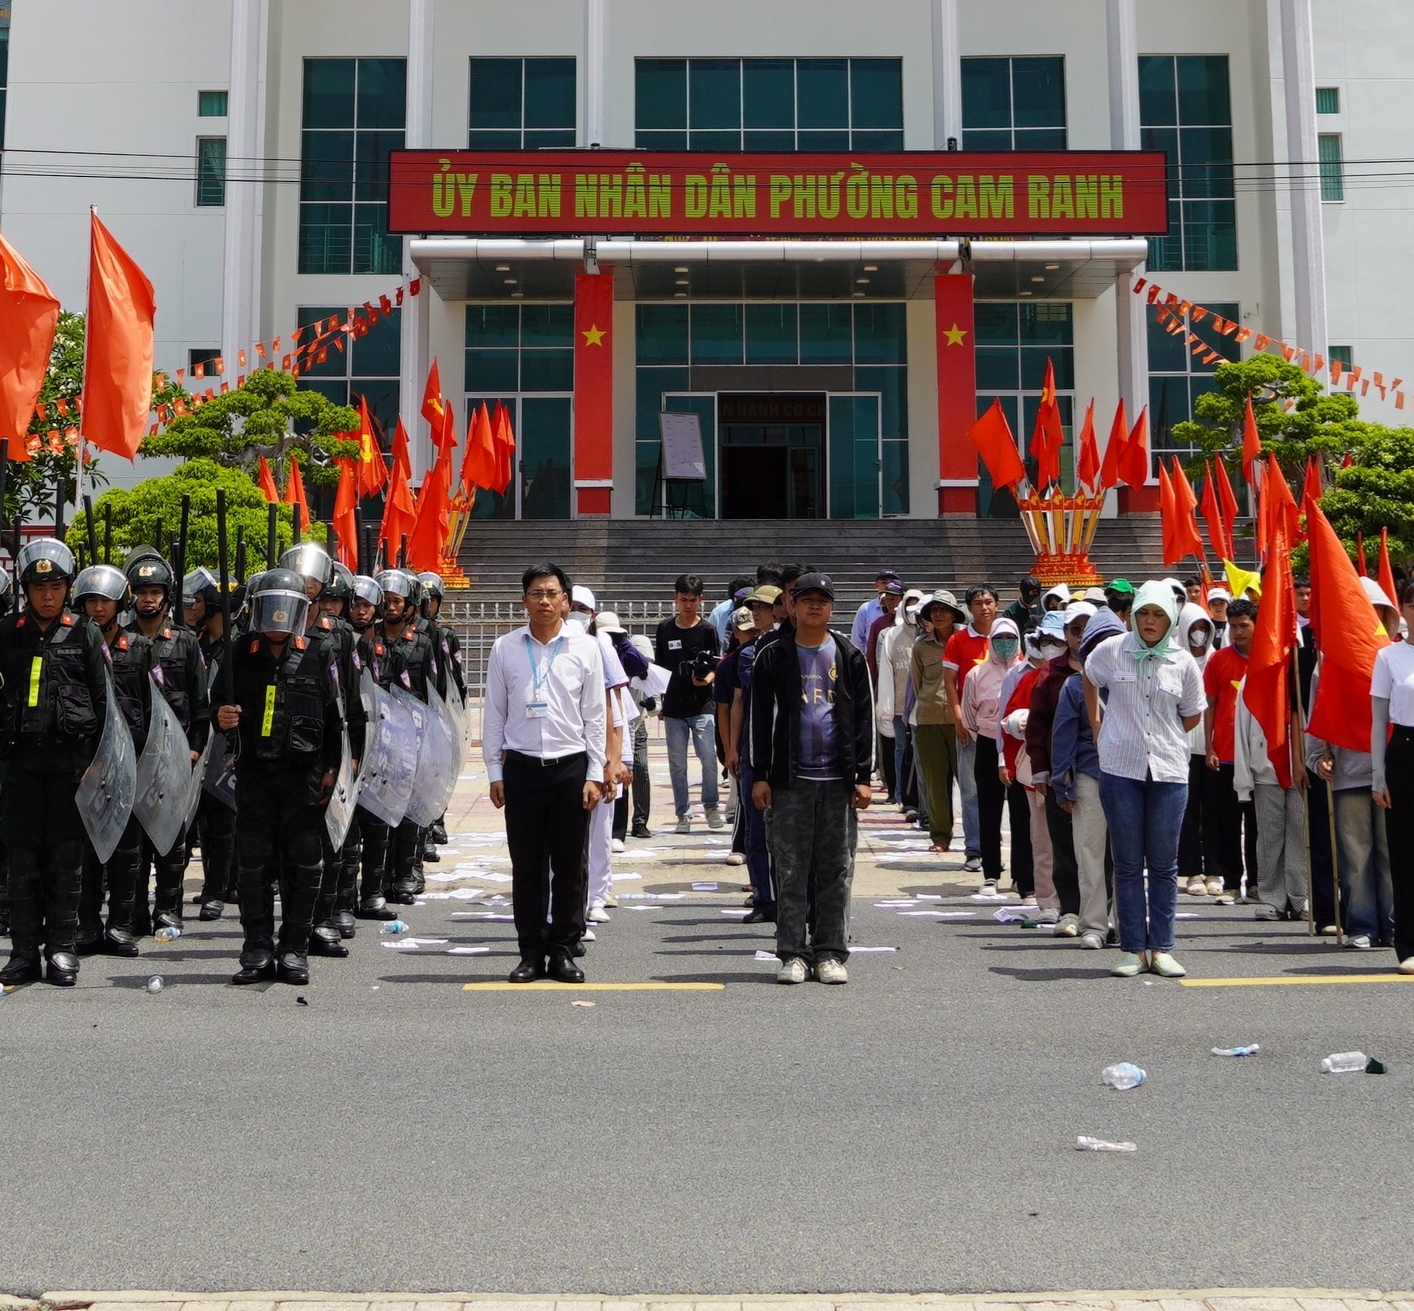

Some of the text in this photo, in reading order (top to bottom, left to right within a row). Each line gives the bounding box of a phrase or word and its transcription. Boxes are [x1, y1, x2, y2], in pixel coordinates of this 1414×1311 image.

[432, 159, 1124, 219] ỦY BAN NHÂN DÂN PHƯỜNG CAM RANH
